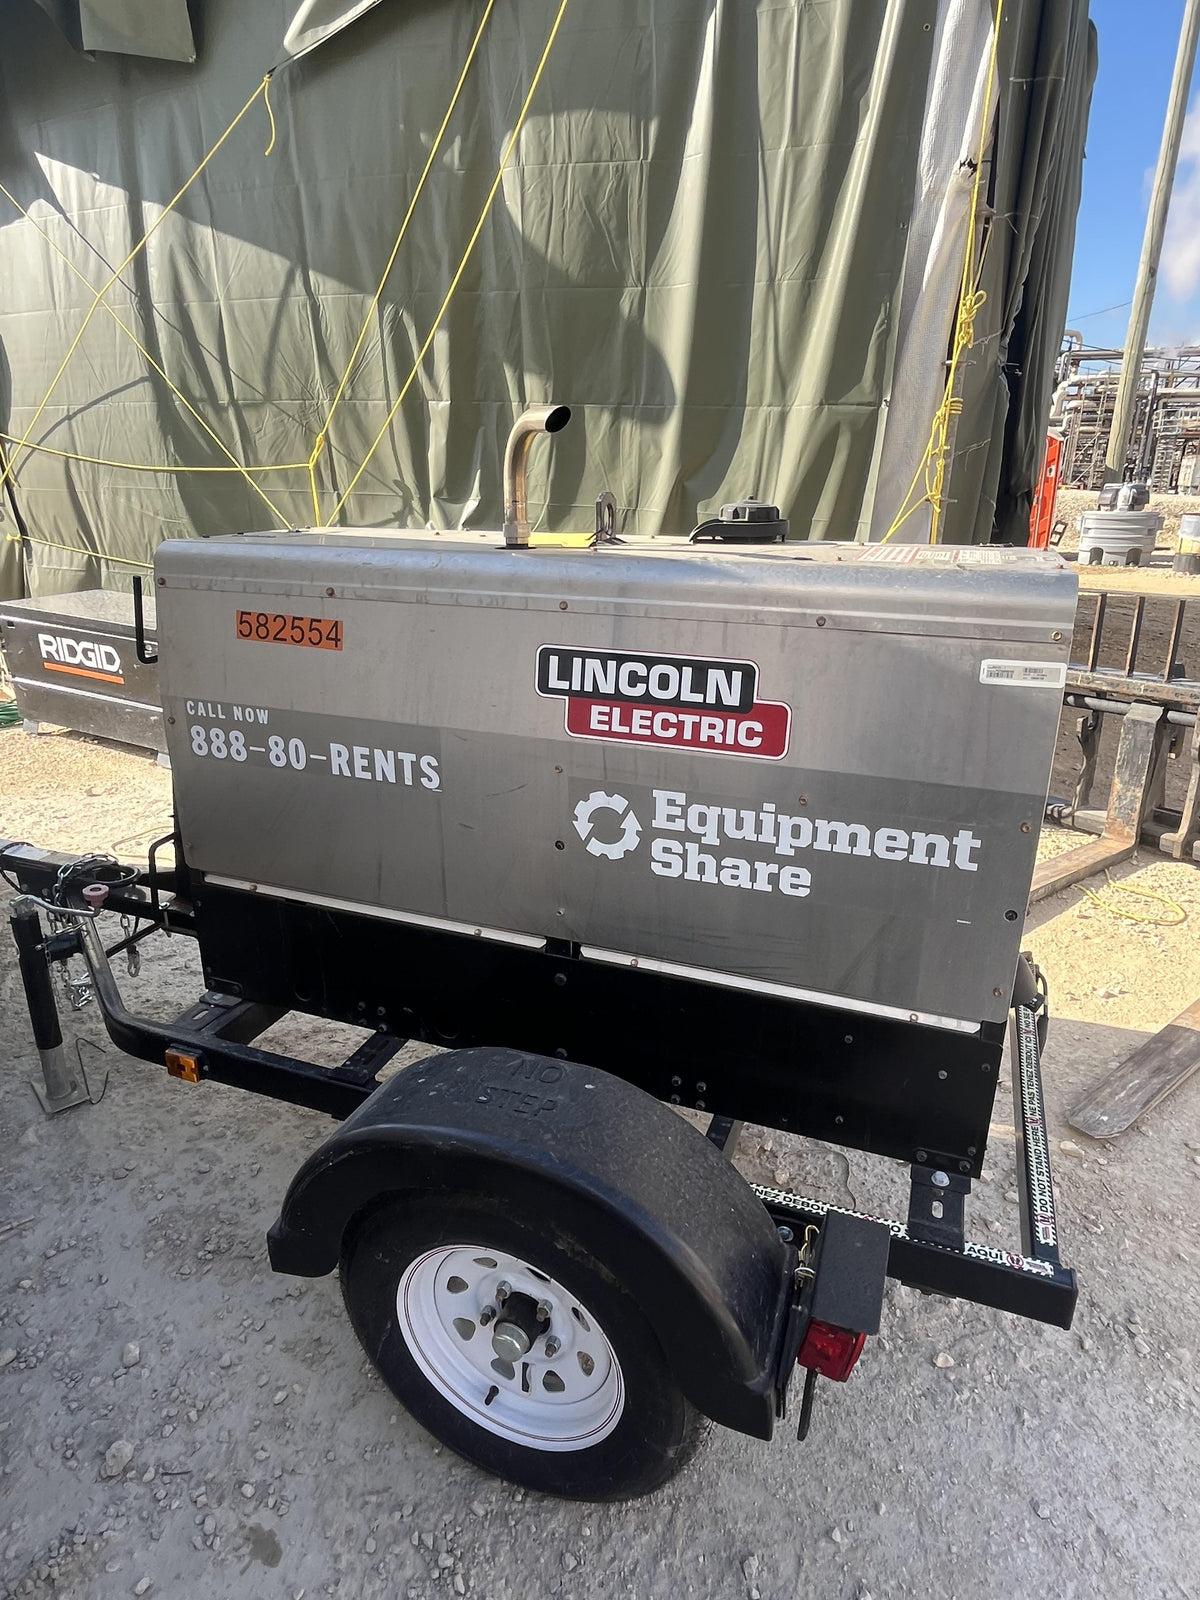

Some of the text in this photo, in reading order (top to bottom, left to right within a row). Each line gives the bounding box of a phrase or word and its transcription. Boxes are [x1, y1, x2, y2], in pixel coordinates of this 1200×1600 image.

[239, 610, 341, 648] 582554
[38, 633, 121, 673] RIDGID
[548, 654, 742, 707] LINCOLN
[186, 700, 268, 724] CALL NOW
[590, 704, 763, 748] ELECTRIC
[190, 725, 440, 790] 888-80-RENTS
[652, 789, 982, 872] Equipment
[651, 837, 811, 897] Share
[511, 1060, 564, 1084] NO
[475, 1086, 558, 1117] STEP
[1027, 1091, 1036, 1106] PAS
[1031, 1126, 1041, 1148] HERE
[1033, 1148, 1045, 1176] STAND
[755, 1188, 781, 1201] NEZ
[1036, 1177, 1047, 1197] NOT
[1039, 1198, 1048, 1212] DO
